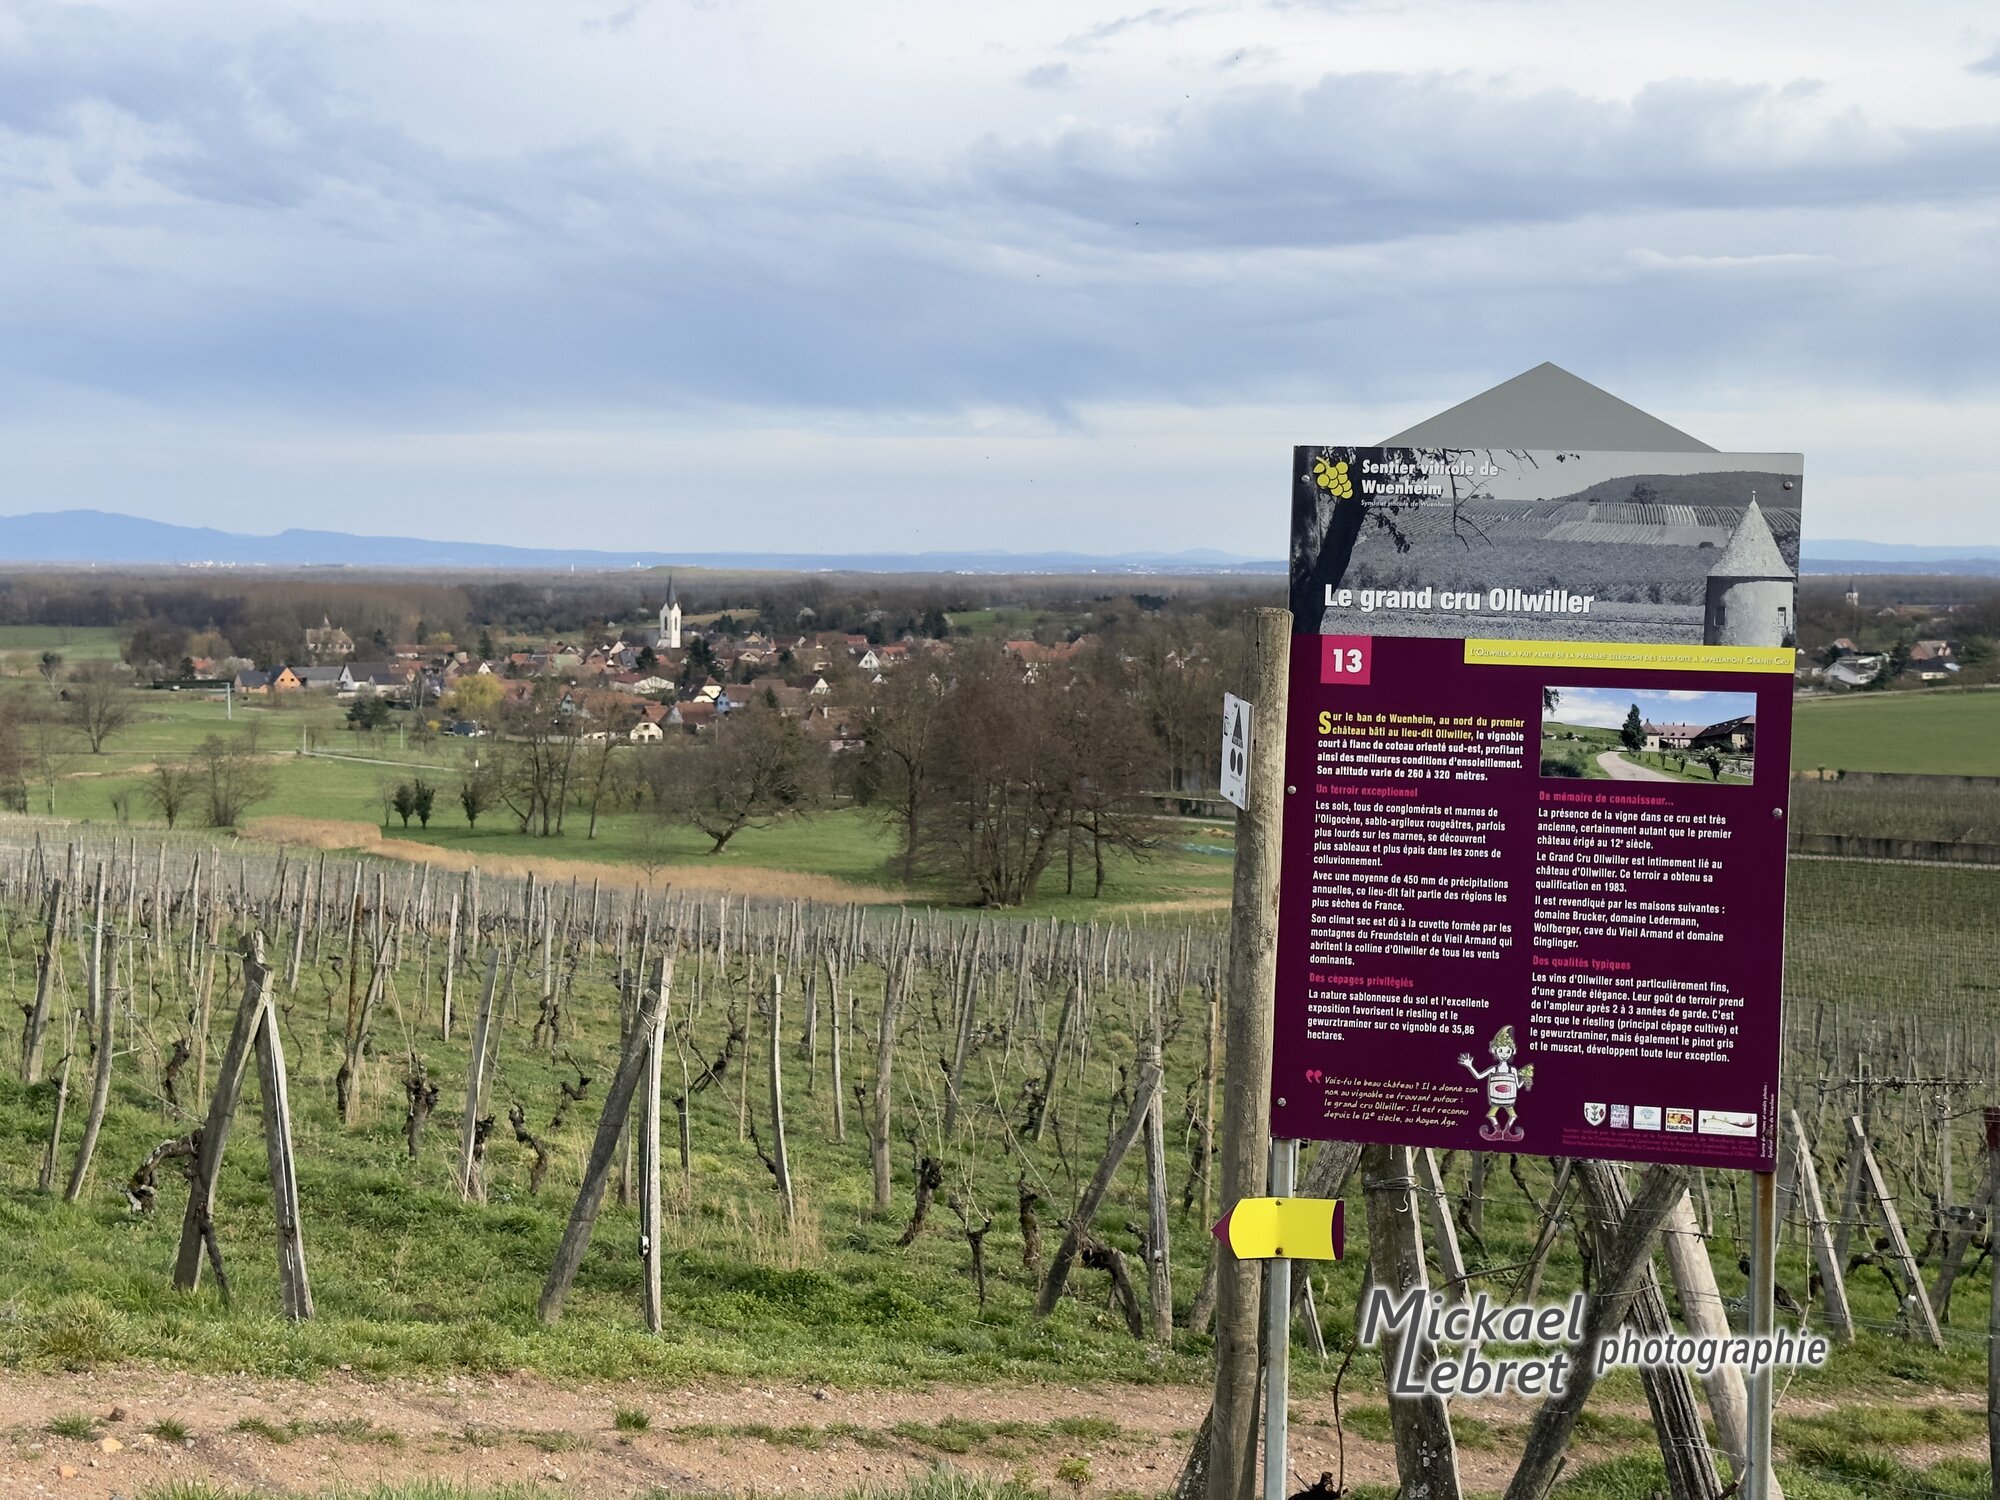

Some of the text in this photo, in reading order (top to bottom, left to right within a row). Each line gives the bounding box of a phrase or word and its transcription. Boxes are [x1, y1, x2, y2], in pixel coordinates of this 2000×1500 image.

[1362, 459, 1499, 476] Sentier viticole de
[1361, 479, 1442, 495] Wuenheim
[1324, 584, 1594, 614] Le grand cru Ollwiller
[1332, 648, 1363, 674] 13
[1318, 710, 1342, 734] Sur
[1345, 712, 1353, 721] le
[1356, 712, 1372, 722] ban
[1375, 713, 1386, 722] de
[1389, 713, 1435, 726] Wuenheim,
[1453, 716, 1472, 725] nord
[1476, 716, 1487, 726] du
[1490, 718, 1524, 728] premier
[1332, 724, 1365, 735] château
[1368, 726, 1385, 736] bâti
[1401, 727, 1432, 737] lieu-dit
[1435, 728, 1473, 741] Ollwiller,
[1476, 730, 1484, 739] le
[1487, 730, 1524, 742] vignoble
[1318, 738, 1523, 755] court à flanc de coteau orienté sud-est, profitant
[1317, 752, 1522, 768] ainsi des meilleures conditions d'ensoleillement.
[1317, 765, 1487, 780] Son altitude varie de 260 à 320 mètres.
[1316, 784, 1328, 793] Un
[1330, 784, 1358, 794] terroir
[1315, 800, 1498, 817] Les sols, tous de conglomérats et marnes de
[1538, 807, 1548, 817] La
[1550, 808, 1588, 819] présence
[1591, 810, 1601, 819] de
[1604, 810, 1612, 819] la
[1615, 810, 1638, 822] vigne
[1640, 811, 1661, 822] dans
[1663, 814, 1673, 822] ce
[1693, 814, 1706, 823] est
[1709, 814, 1726, 824] très
[1313, 854, 1382, 866] colluvionnement.
[1536, 851, 1546, 861] Le
[1549, 851, 1573, 862] Grand
[1576, 853, 1590, 862] Cru
[1593, 853, 1629, 864] Ollwiller
[1631, 856, 1644, 865] est
[1647, 856, 1695, 867] intimement
[1698, 858, 1709, 868] lié
[1312, 870, 1508, 888] Avec une moyenne de 450 mm de précipitations
[1534, 908, 1570, 920] domaine
[1572, 910, 1607, 923] Brucker,
[1610, 912, 1646, 923] domaine
[1357, 929, 1367, 938] du
[1421, 932, 1429, 942] et
[1431, 933, 1442, 942] du
[1444, 933, 1462, 943] Vieil
[1464, 934, 1496, 945] Armand
[1499, 936, 1512, 947] qui
[1584, 927, 1603, 935] cave
[1606, 926, 1616, 936] du
[1619, 926, 1637, 937] Vieil
[1640, 928, 1673, 938] Armand
[1676, 930, 1684, 939] et
[1686, 930, 1723, 941] domaine
[1531, 985, 1554, 996] d'une
[1557, 988, 1586, 998] grande
[1632, 991, 1651, 1001] Leur
[1654, 992, 1673, 1004] goût
[1675, 994, 1686, 1003] de
[1688, 994, 1716, 1005] terroir
[1719, 997, 1744, 1007] prend
[1307, 1029, 1344, 1040] hectares.
